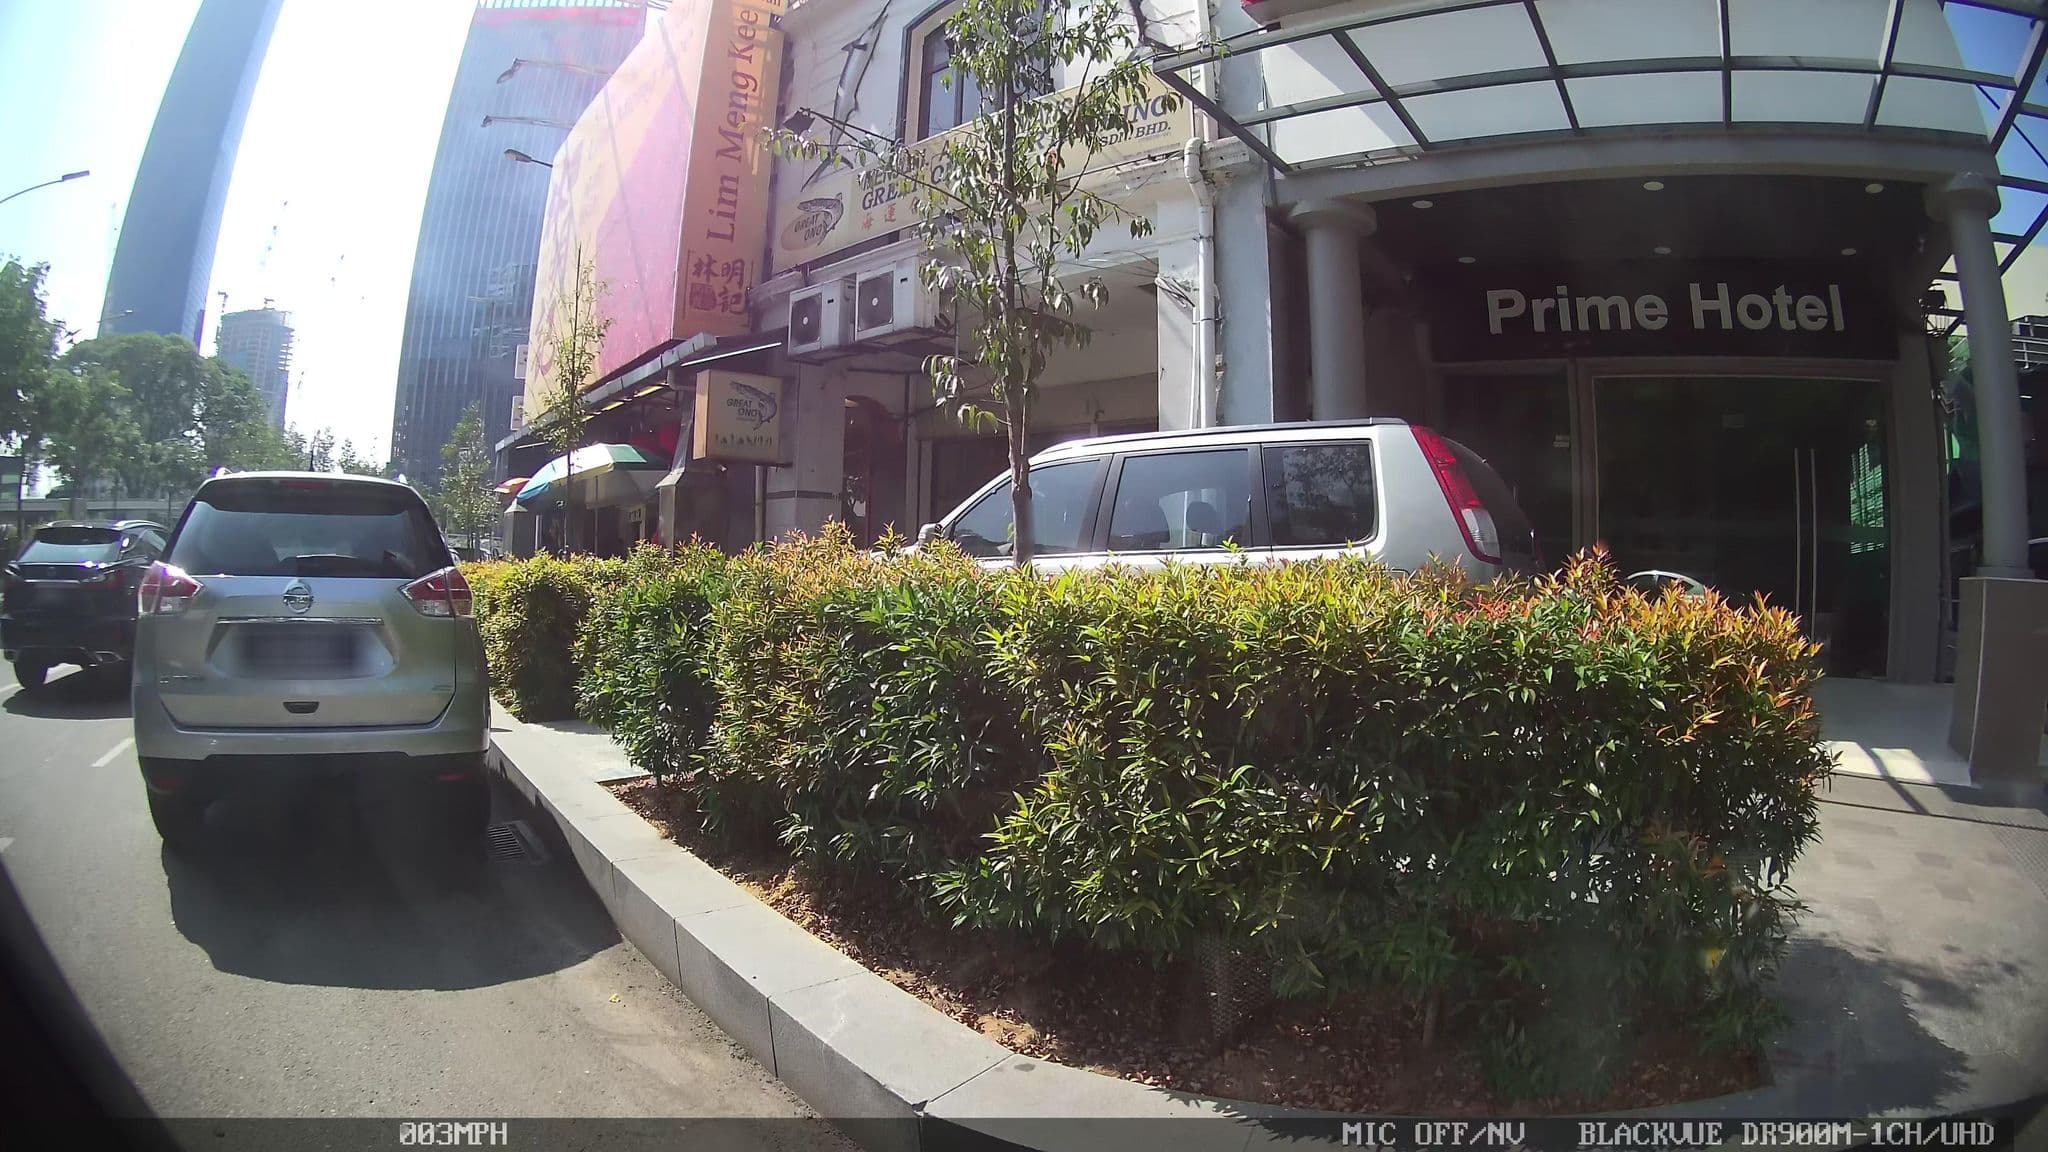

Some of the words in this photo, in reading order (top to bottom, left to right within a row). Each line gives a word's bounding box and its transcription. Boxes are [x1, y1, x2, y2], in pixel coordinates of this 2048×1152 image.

[728, 10, 758, 64] Kee
[716, 70, 758, 163] Meng
[1134, 120, 1171, 139] BHD.
[706, 174, 740, 244] Lim
[794, 213, 821, 233] GREAT
[1486, 285, 1669, 335] Prime
[1689, 282, 1845, 332] Hotel
[726, 398, 753, 409] GREAT
